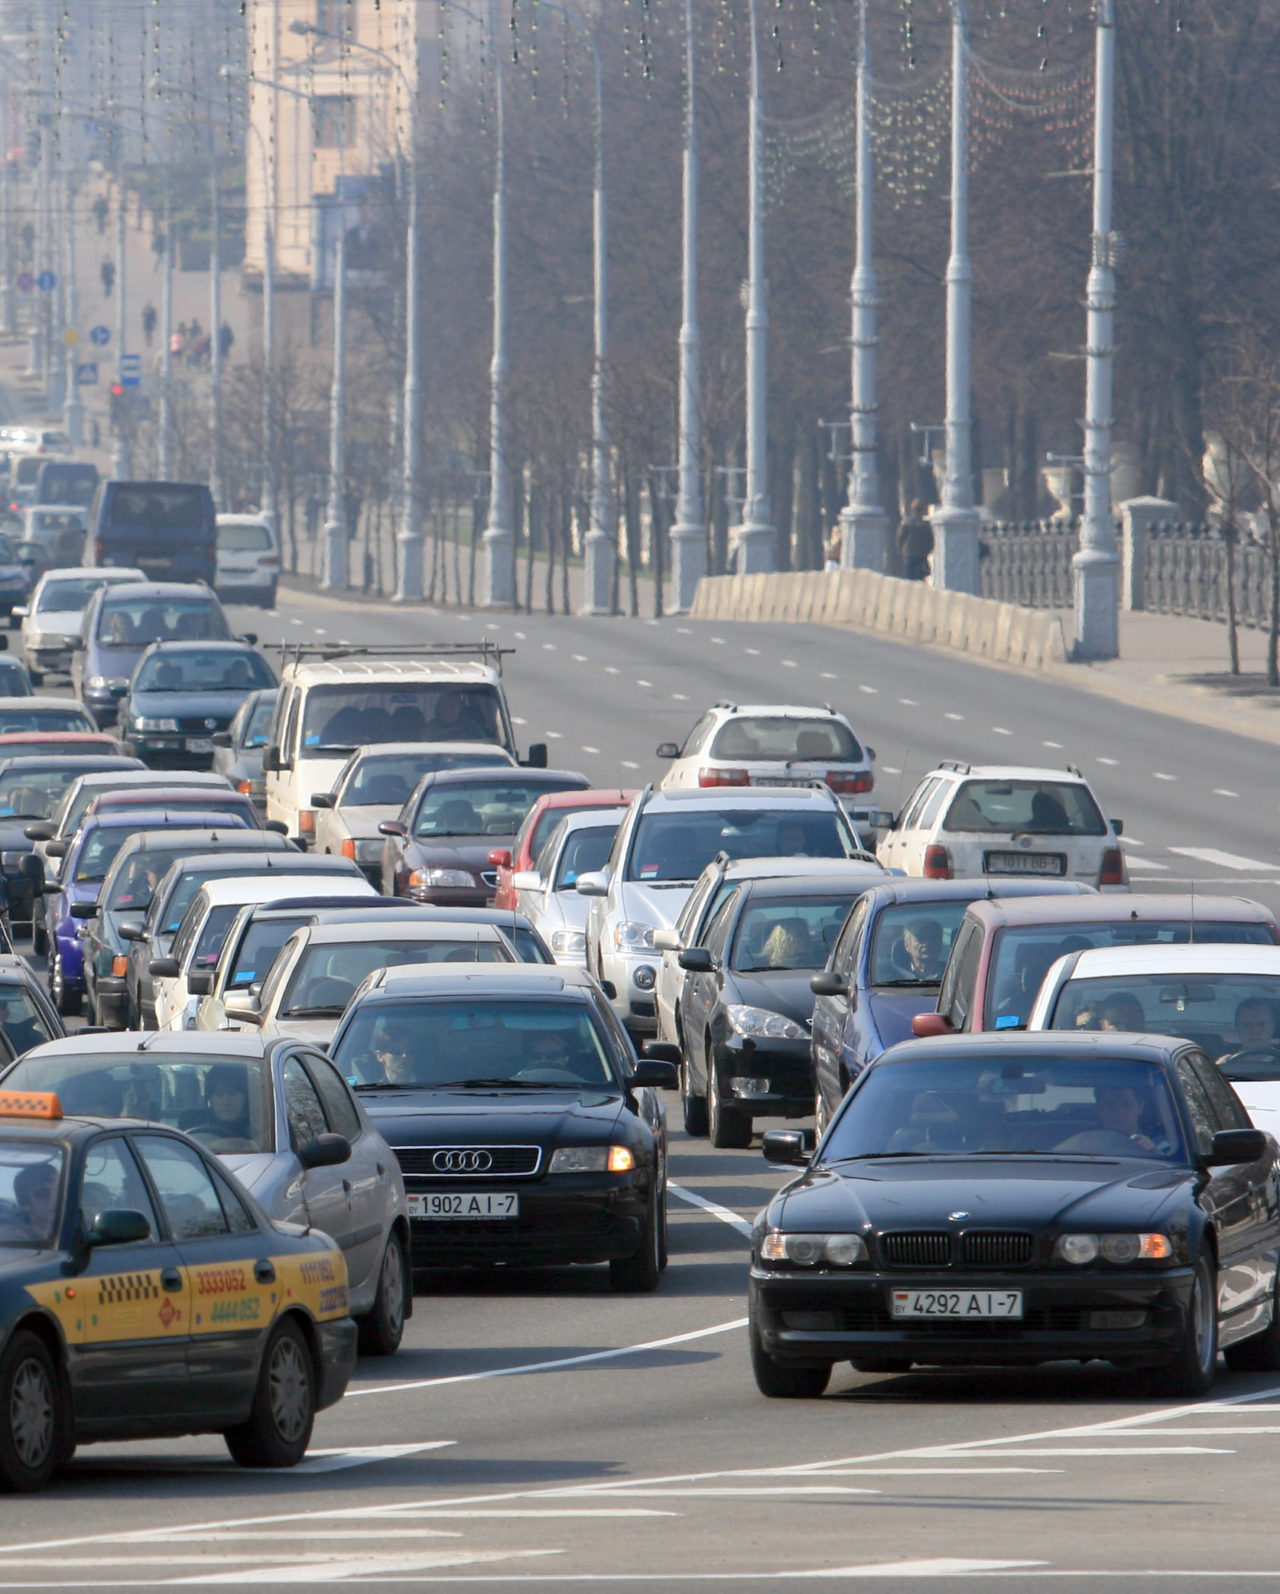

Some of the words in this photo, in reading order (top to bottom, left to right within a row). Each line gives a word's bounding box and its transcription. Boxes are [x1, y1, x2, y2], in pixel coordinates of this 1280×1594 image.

[422, 1195, 462, 1214] 1902
[196, 1268, 247, 1295] 3333052
[210, 1297, 261, 1323] 4444052
[913, 1294, 960, 1314] 4292
